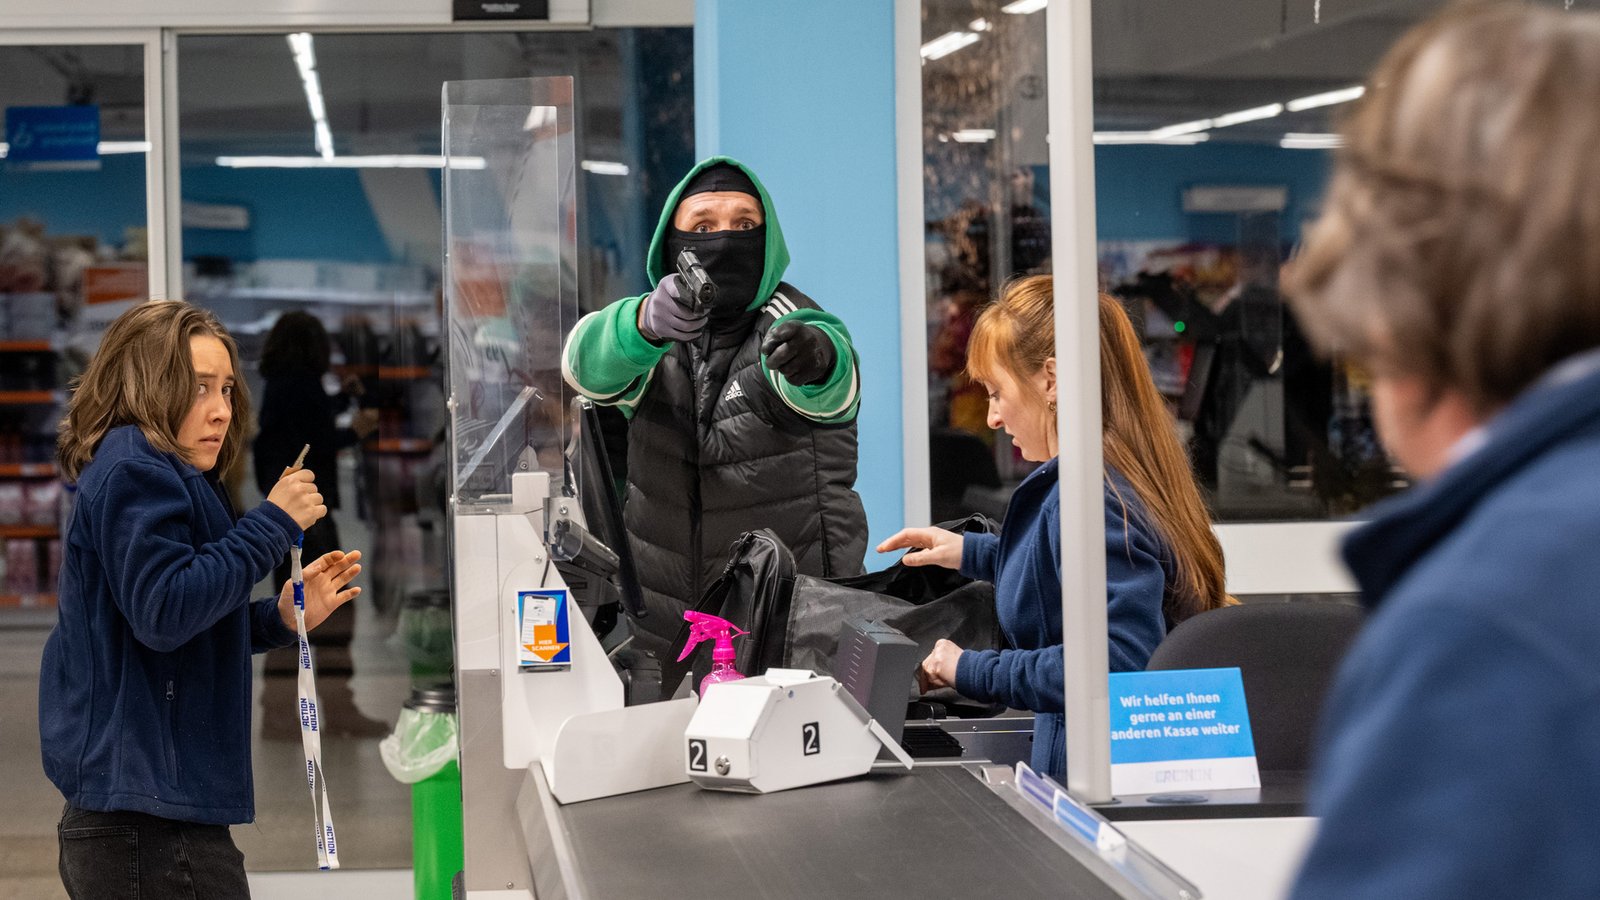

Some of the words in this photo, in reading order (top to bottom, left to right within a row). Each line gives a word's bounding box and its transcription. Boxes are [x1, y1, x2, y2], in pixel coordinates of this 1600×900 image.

[301, 640, 311, 669] ACTION
[300, 698, 310, 726] ACTION
[1120, 695, 1142, 707] Wir
[1144, 693, 1184, 706] helfen
[1186, 692, 1221, 704] Ihnen
[309, 702, 318, 731] ACTION
[1130, 712, 1165, 725] gerne
[1168, 711, 1182, 721] an
[1185, 708, 1217, 719] einer
[804, 725, 818, 754] 2
[1111, 728, 1160, 740] anderen
[1163, 726, 1199, 737] Kasse
[1201, 723, 1240, 735] weiter
[690, 741, 705, 770] 2
[326, 825, 336, 855] ACTION
